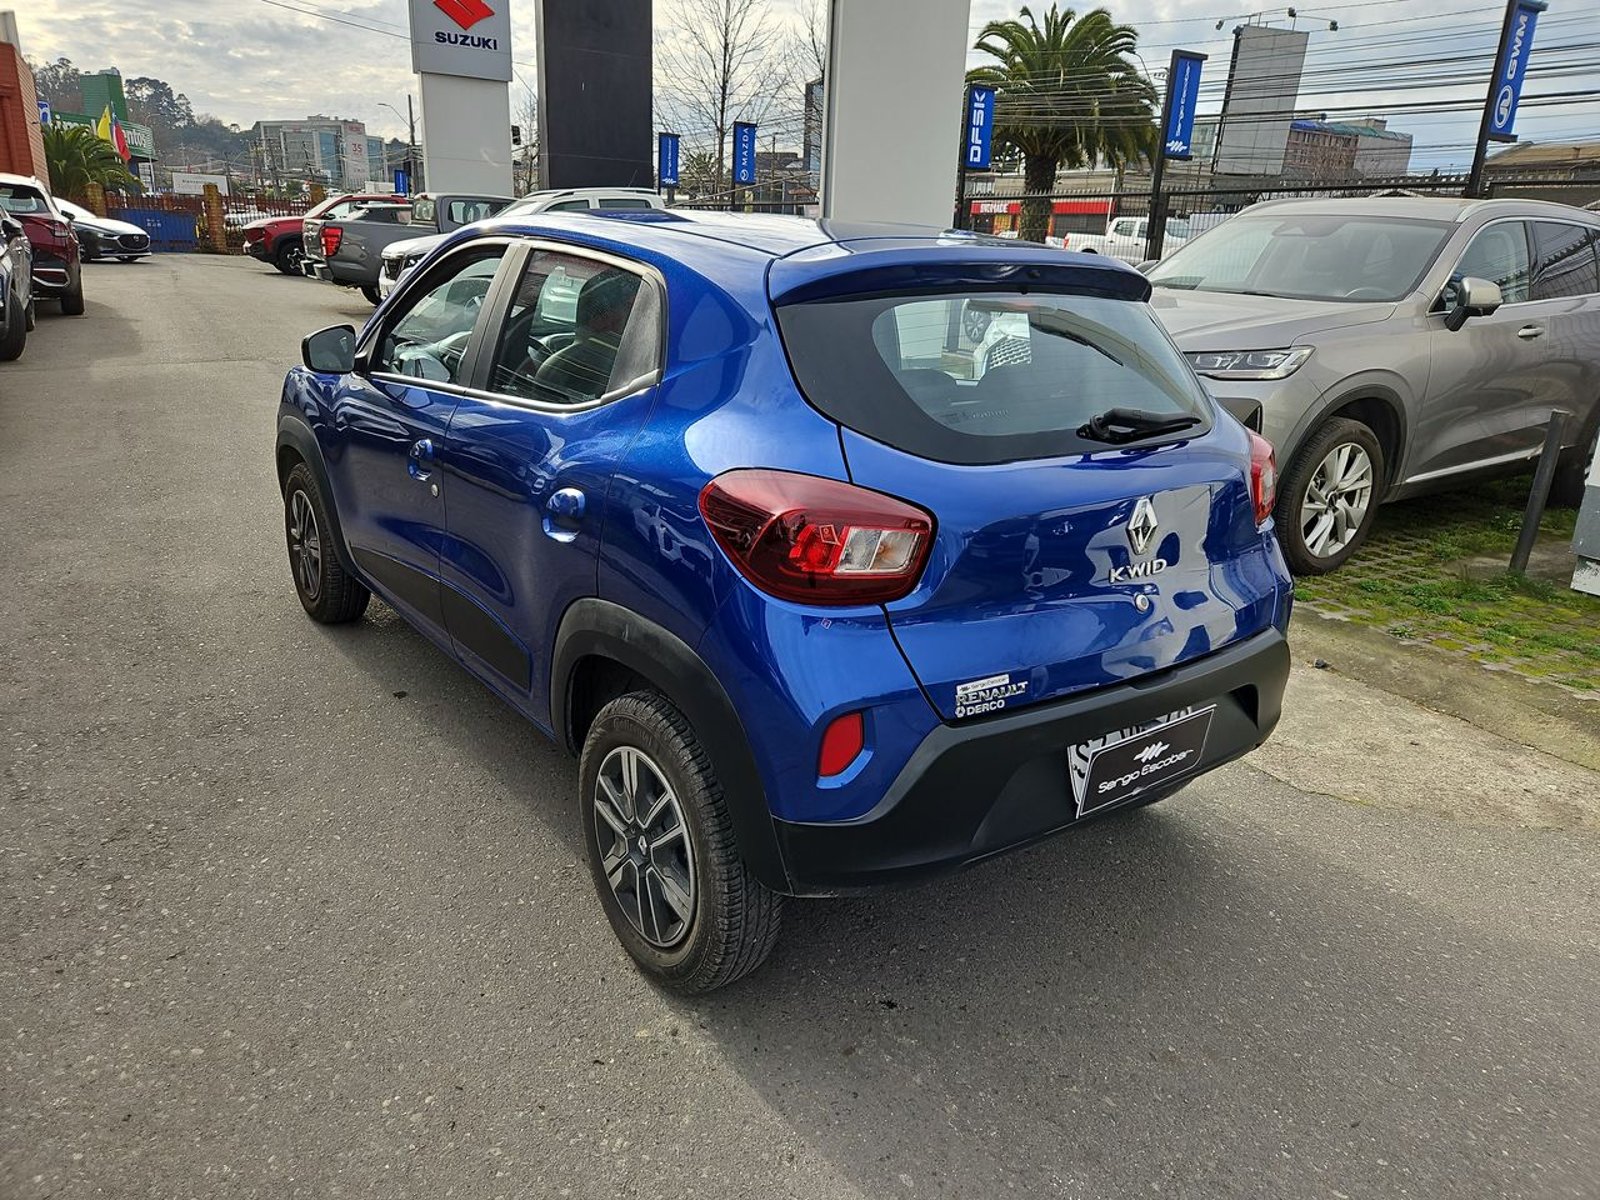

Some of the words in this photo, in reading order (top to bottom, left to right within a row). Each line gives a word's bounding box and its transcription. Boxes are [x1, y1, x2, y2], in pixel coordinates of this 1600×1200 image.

[434, 31, 498, 50] SUZUKI
[1507, 15, 1528, 80] GWM
[969, 91, 986, 162] DFSK
[351, 143, 363, 153] 35
[741, 128, 750, 167] MAZDA
[1109, 558, 1167, 583] KWID
[955, 681, 1029, 706] RENAULT
[966, 699, 1006, 716] DERCO
[1141, 749, 1194, 776] Escobar
